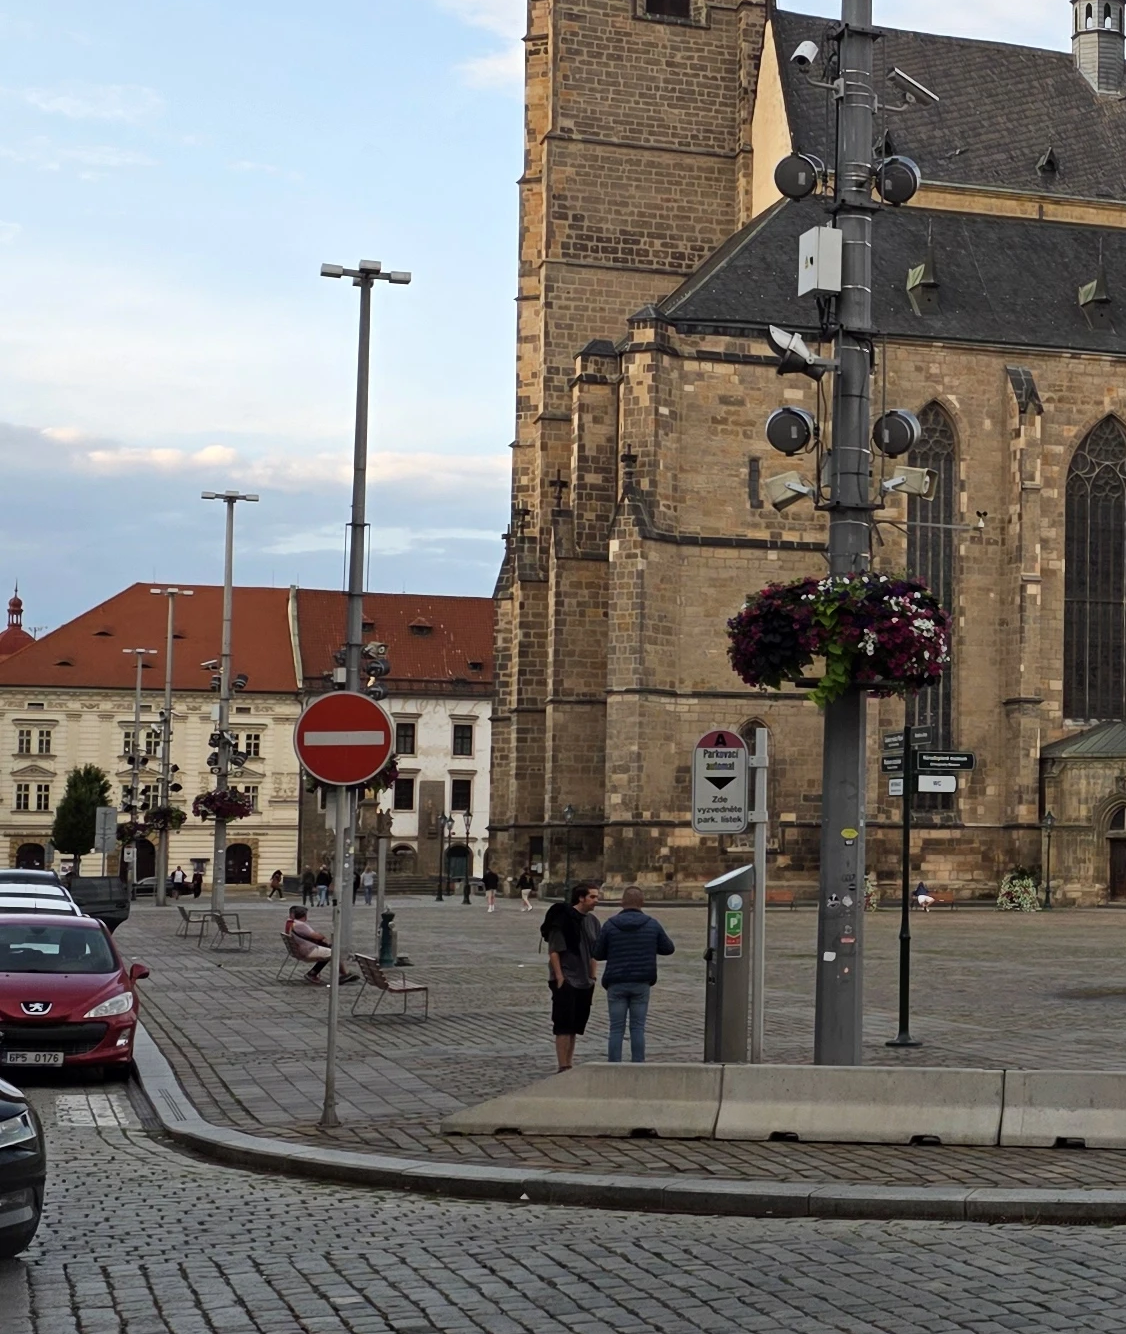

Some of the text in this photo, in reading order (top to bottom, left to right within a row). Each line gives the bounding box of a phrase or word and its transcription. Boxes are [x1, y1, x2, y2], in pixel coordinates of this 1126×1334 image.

[714, 733, 727, 747] A
[703, 749, 739, 759] Parkovací
[697, 805, 743, 815] vyzvedněte
[697, 815, 743, 824] park. lístek
[730, 917, 738, 929] P
[34, 1053, 59, 1063] 0176
